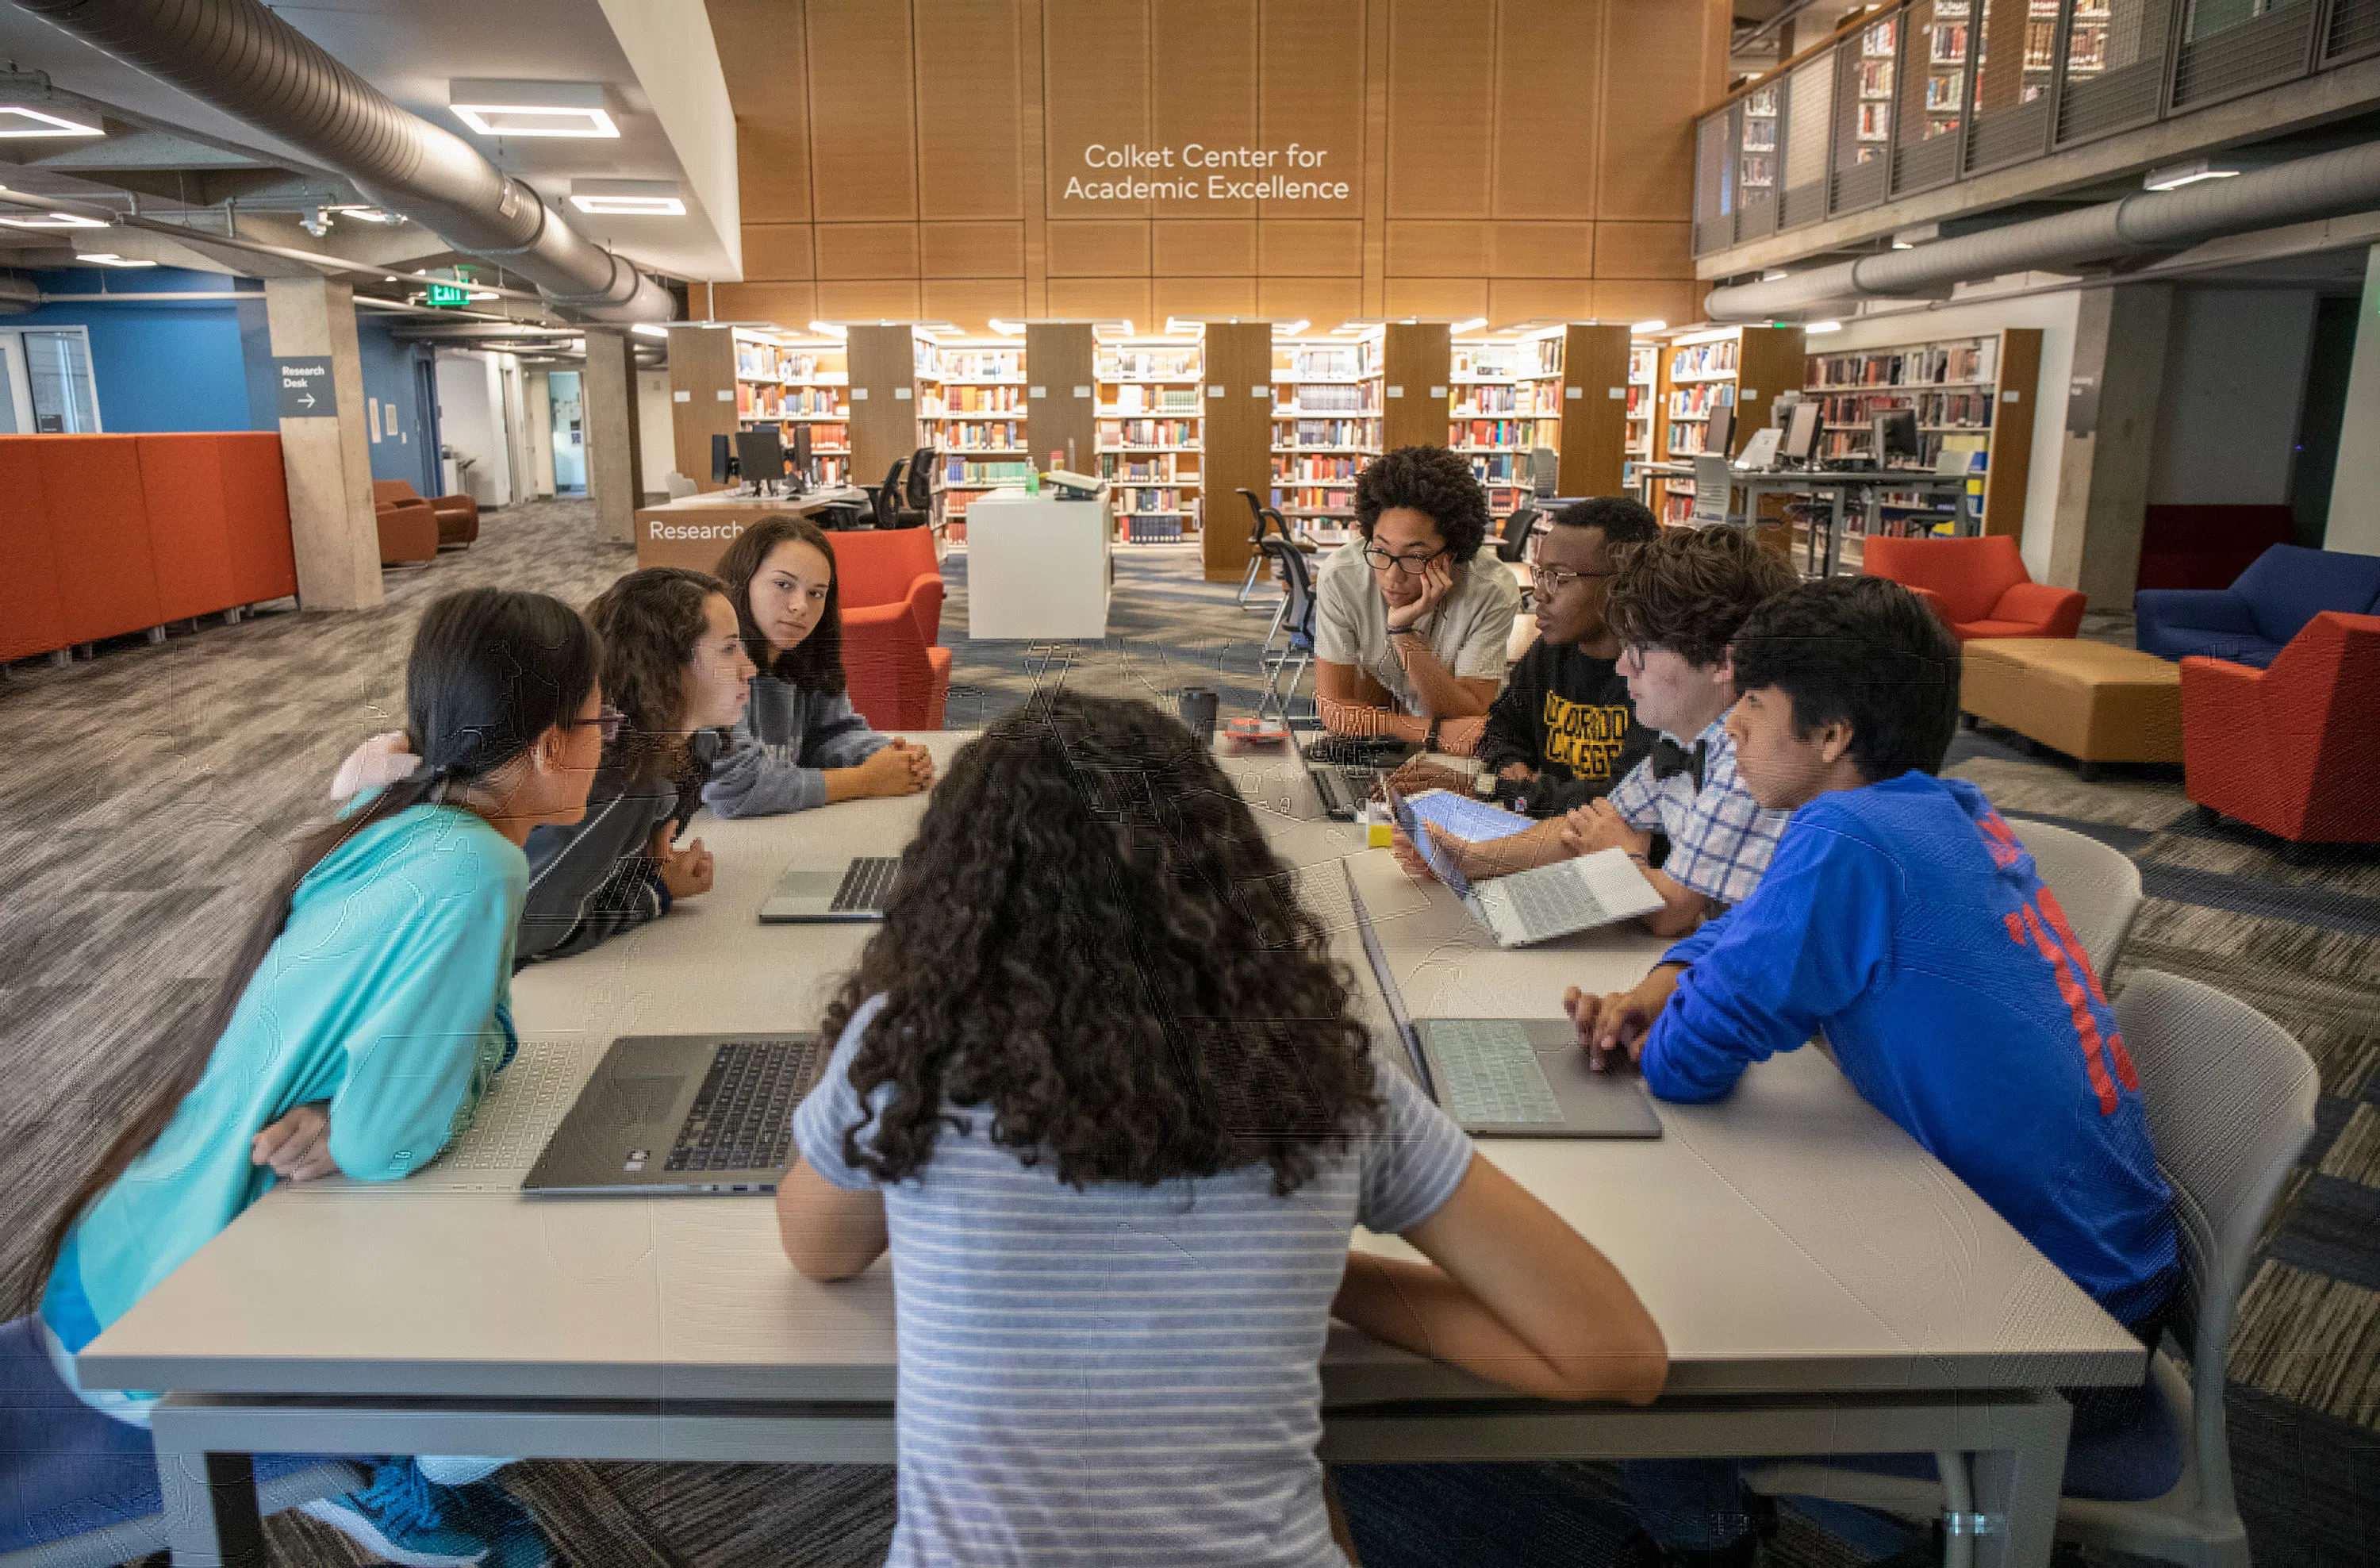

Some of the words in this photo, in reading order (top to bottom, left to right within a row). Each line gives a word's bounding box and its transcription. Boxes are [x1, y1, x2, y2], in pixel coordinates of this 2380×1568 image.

[1084, 144, 1174, 167] Colket
[1182, 144, 1278, 167] Center
[1285, 143, 1327, 167] for
[1064, 175, 1199, 199] Academic
[1208, 175, 1349, 199] Excellence
[282, 365, 325, 376] Research
[283, 377, 308, 388] Desk
[650, 520, 745, 540] Research
